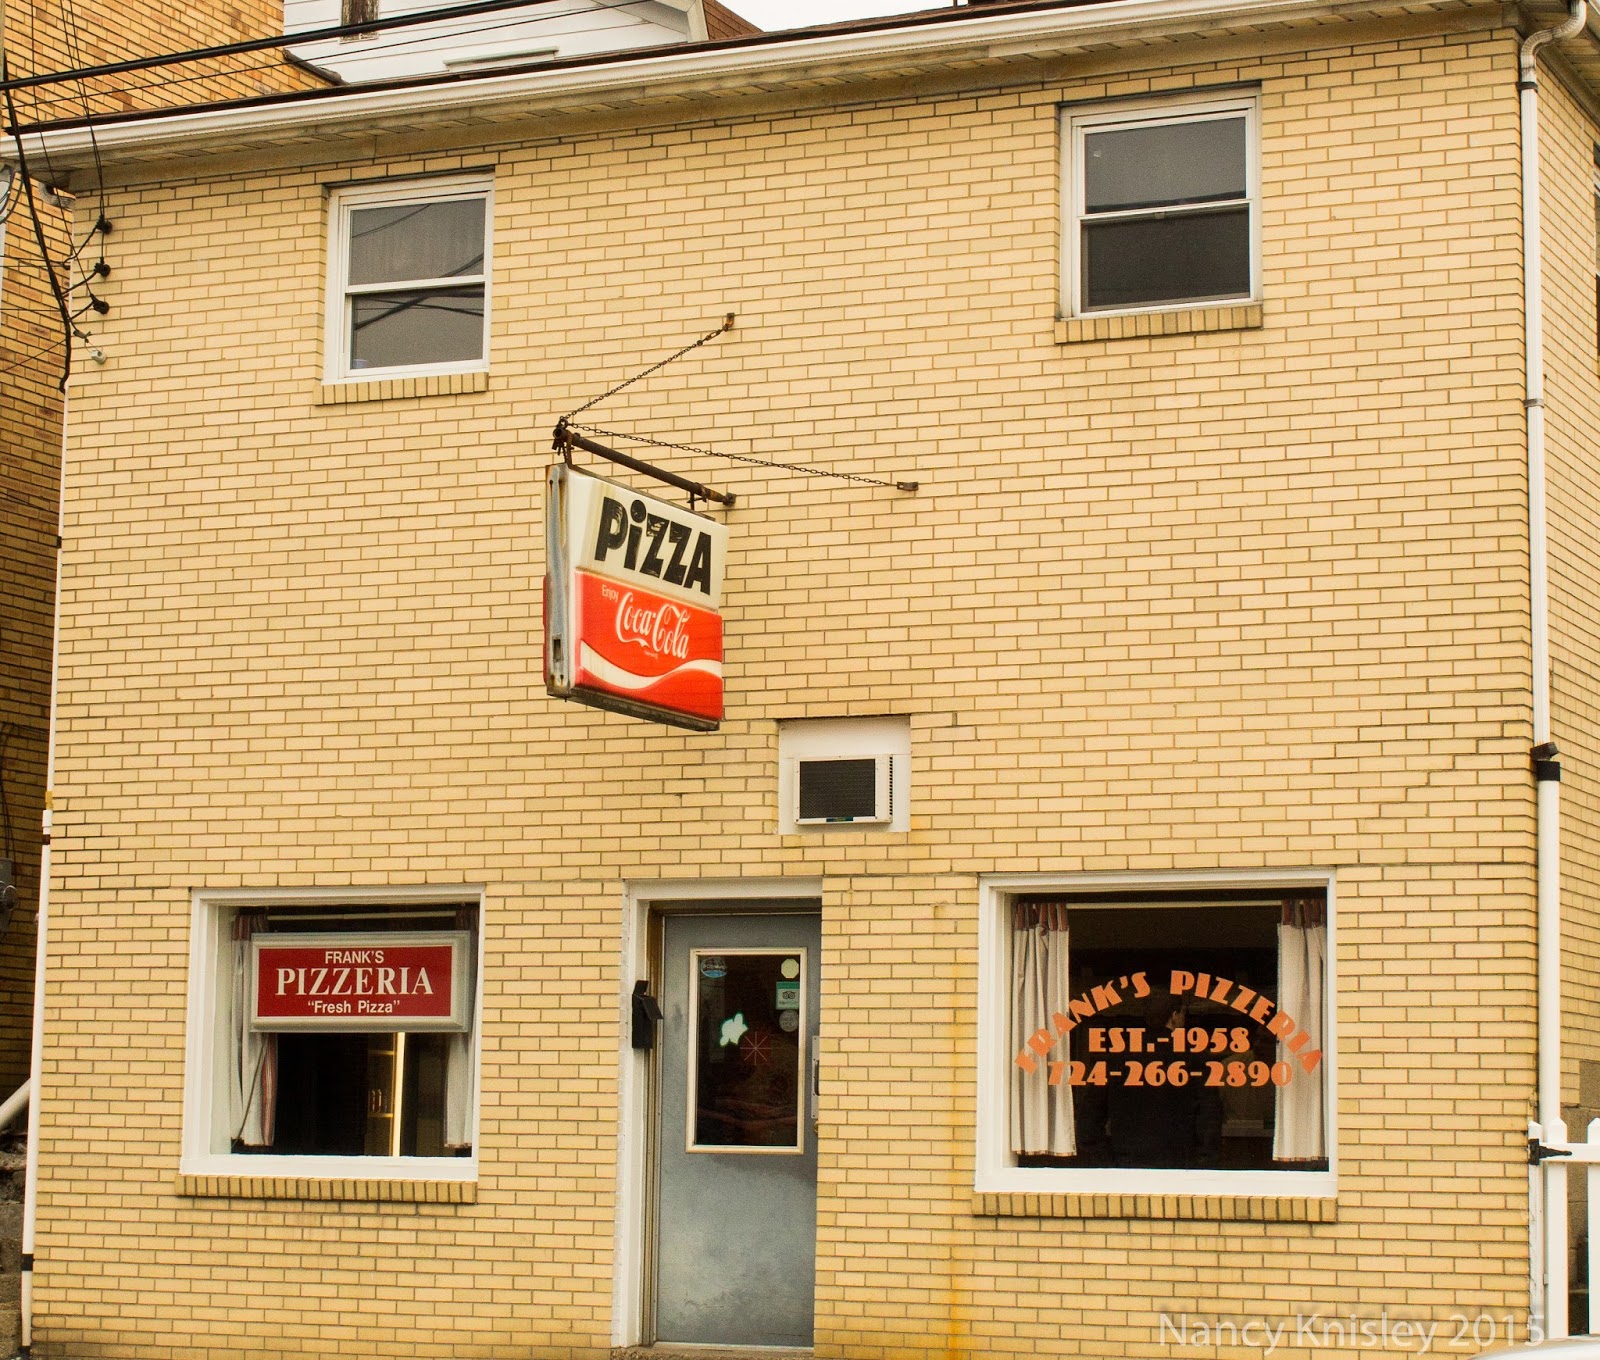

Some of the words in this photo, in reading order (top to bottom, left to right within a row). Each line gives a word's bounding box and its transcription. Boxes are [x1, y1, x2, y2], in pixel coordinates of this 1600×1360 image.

[602, 584, 619, 603] Enjoy
[616, 591, 691, 660] Coca-Cola
[325, 950, 385, 964] FRANK'S
[275, 966, 434, 996] PIZZERIA
[1014, 971, 1150, 1077] FRANK'S
[1169, 969, 1323, 1076] PIZZERIA
[1047, 1060, 1293, 1088] 724-266-2890
